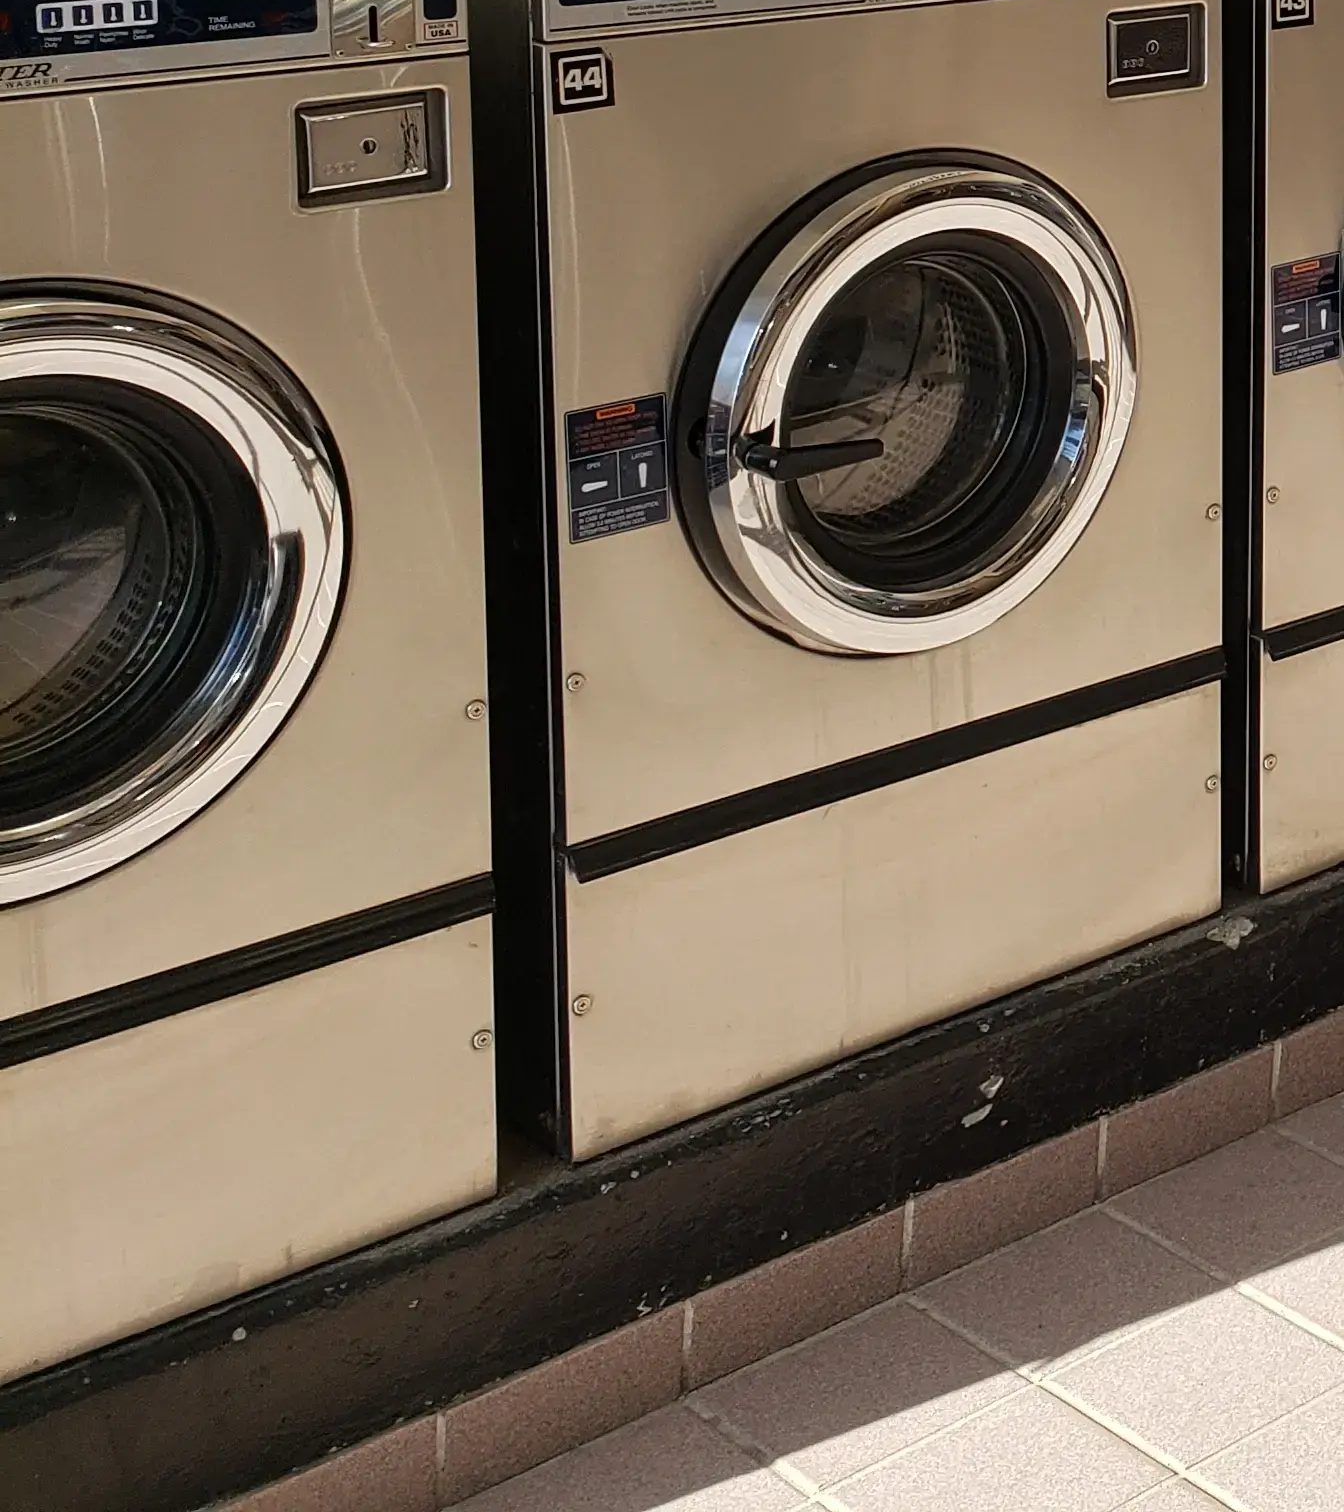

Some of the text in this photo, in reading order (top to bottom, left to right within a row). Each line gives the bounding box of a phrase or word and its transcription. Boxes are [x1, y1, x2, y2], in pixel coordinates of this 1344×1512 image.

[208, 21, 256, 32] REMAINING
[430, 28, 452, 38] USA
[5, 77, 59, 88] WASHER
[564, 66, 602, 91] 44
